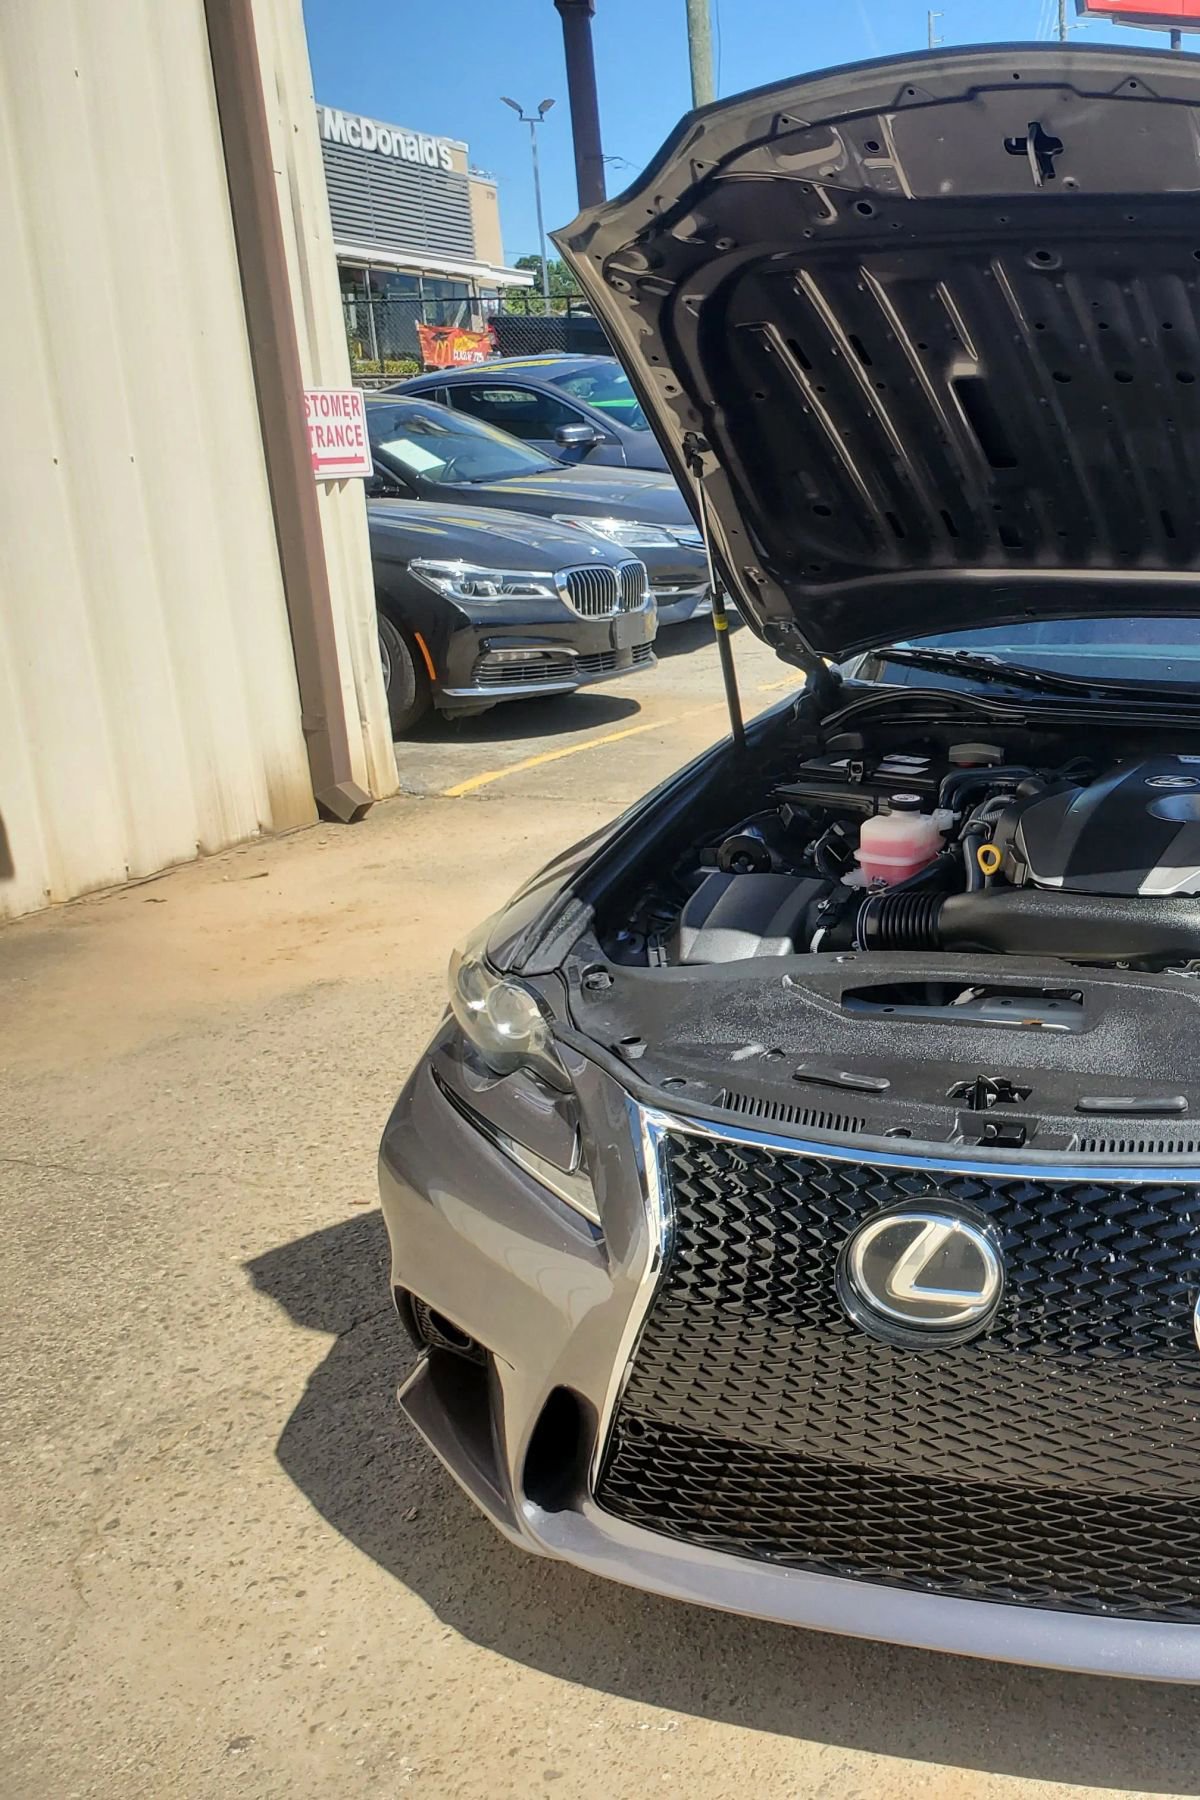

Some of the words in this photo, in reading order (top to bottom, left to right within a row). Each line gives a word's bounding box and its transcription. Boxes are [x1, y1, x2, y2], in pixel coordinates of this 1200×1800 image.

[324, 107, 453, 170] McDonald's
[304, 395, 360, 417] STOMER
[305, 425, 363, 448] TRANCE
